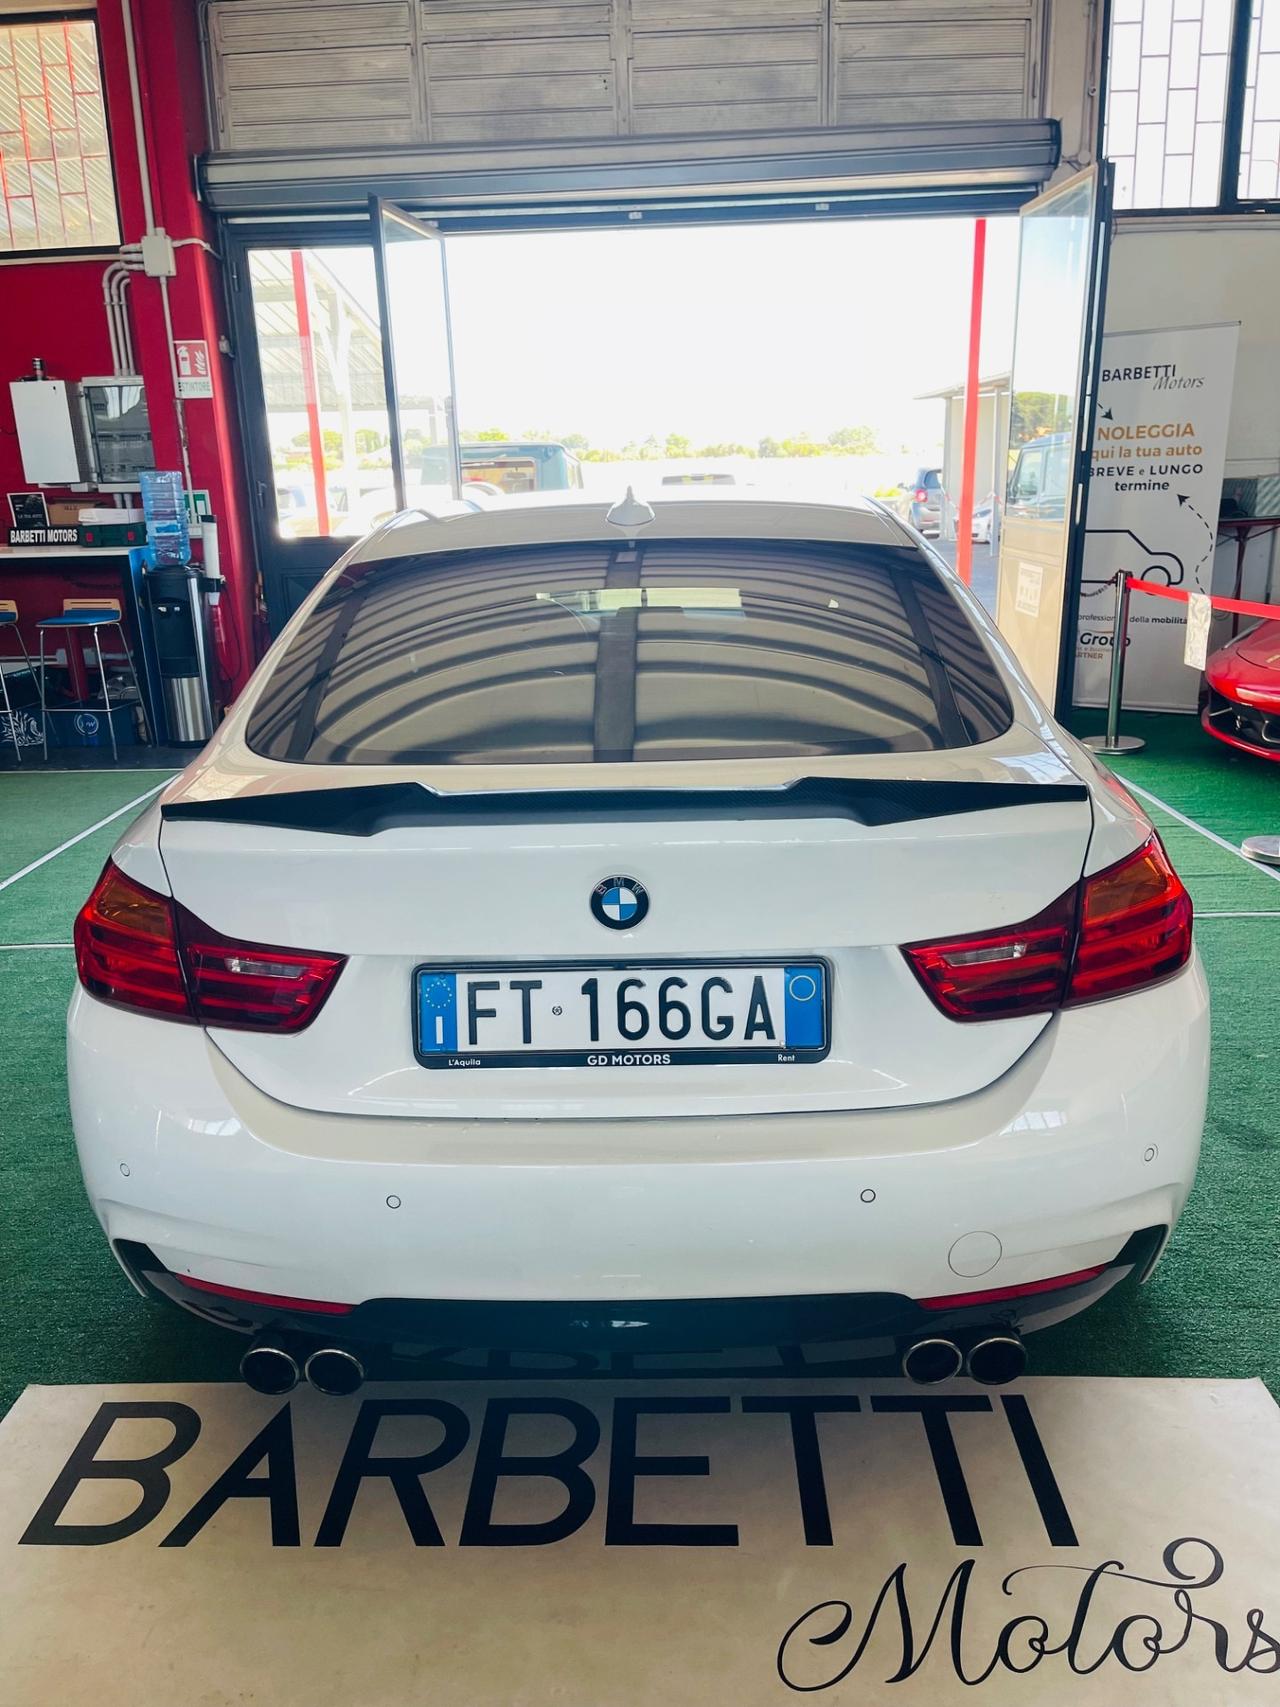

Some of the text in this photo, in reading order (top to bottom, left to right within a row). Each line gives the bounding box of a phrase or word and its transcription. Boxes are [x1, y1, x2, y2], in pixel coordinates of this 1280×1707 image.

[1102, 364, 1176, 382] BARBETTI
[1152, 376, 1205, 391] Motors
[1097, 423, 1195, 441] NOLEGGIA
[1091, 444, 1203, 461] qui la tua auto
[1138, 468, 1145, 476] e
[1150, 464, 1203, 475] LUNGO
[1114, 479, 1170, 491] termine
[10, 528, 78, 543] BARBETTI MOTORS
[595, 877, 645, 895] BMW
[467, 979, 543, 1045] FT
[581, 975, 777, 1042] 166GA
[448, 1054, 796, 1067] L'Aquila GD MOTORS Rent
[18, 1394, 1080, 1548] BARBETTI
[777, 1537, 1280, 1692] Motors
